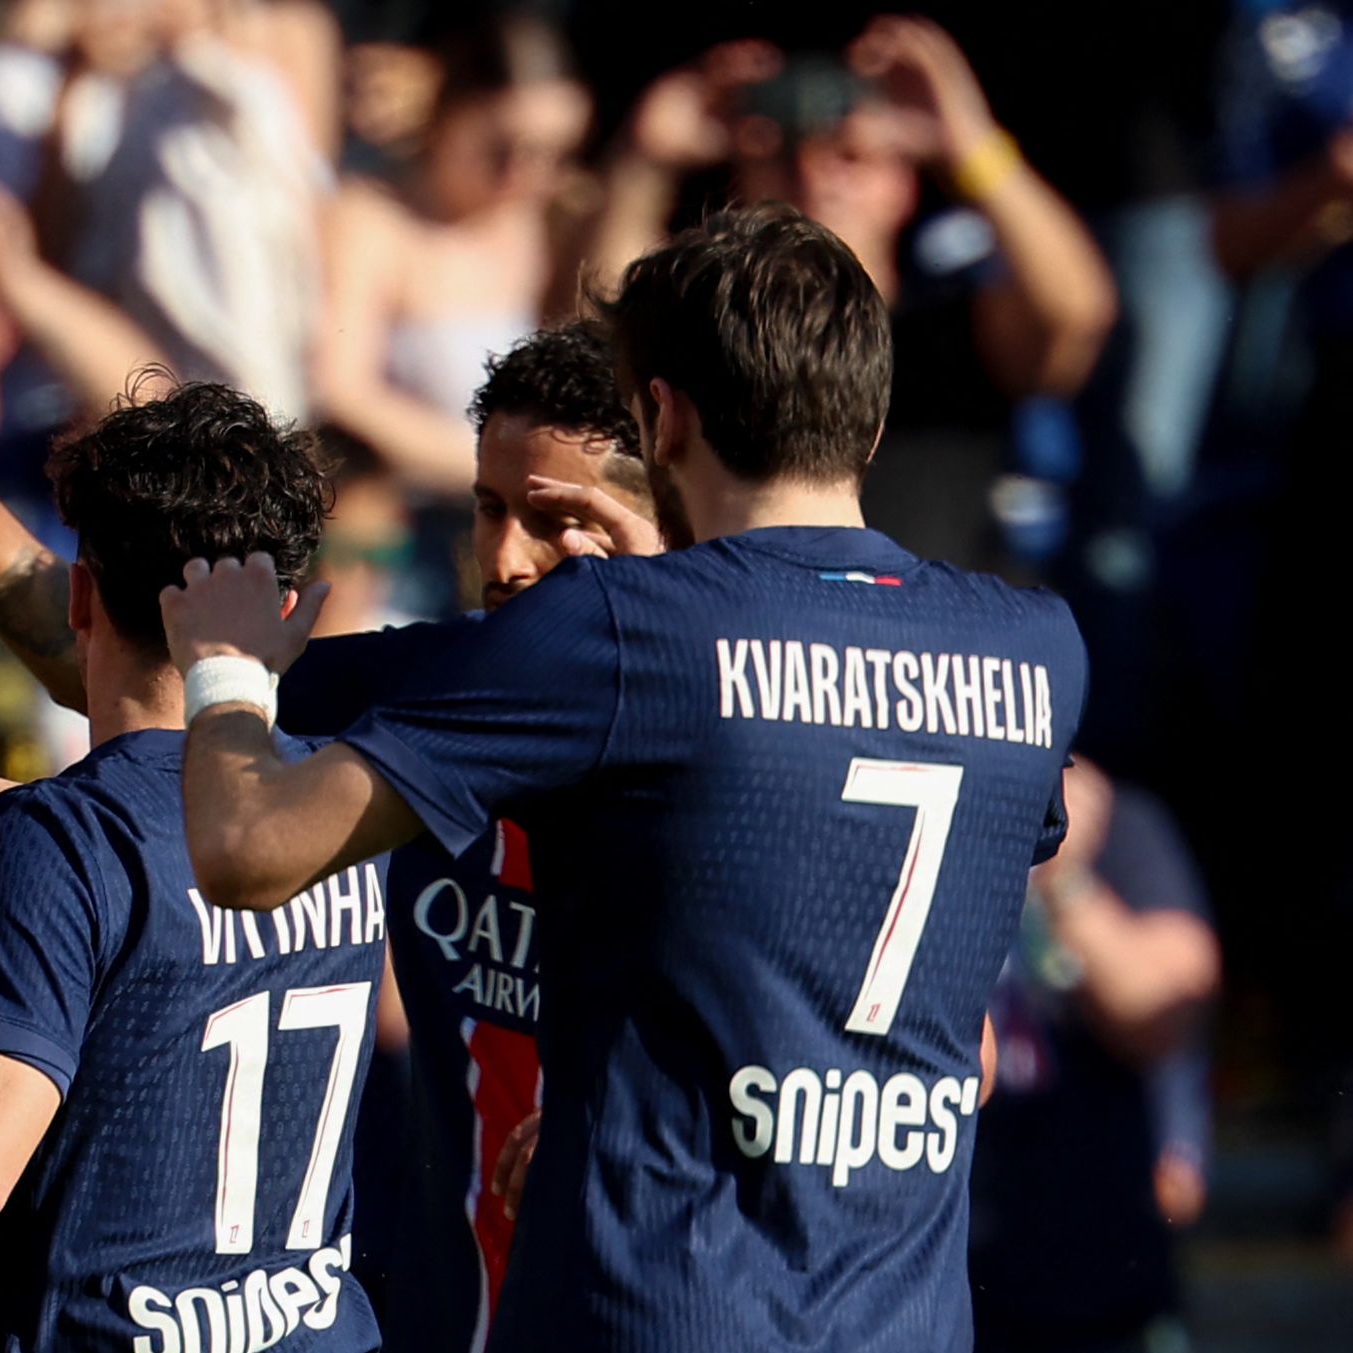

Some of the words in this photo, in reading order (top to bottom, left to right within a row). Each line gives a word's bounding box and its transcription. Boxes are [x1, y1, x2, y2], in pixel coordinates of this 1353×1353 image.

[716, 638, 1053, 749] KVARATSKHELIA
[413, 877, 540, 974] QAT
[841, 757, 964, 1036] 7
[201, 981, 372, 1255] 17
[729, 1065, 962, 1188] snipes
